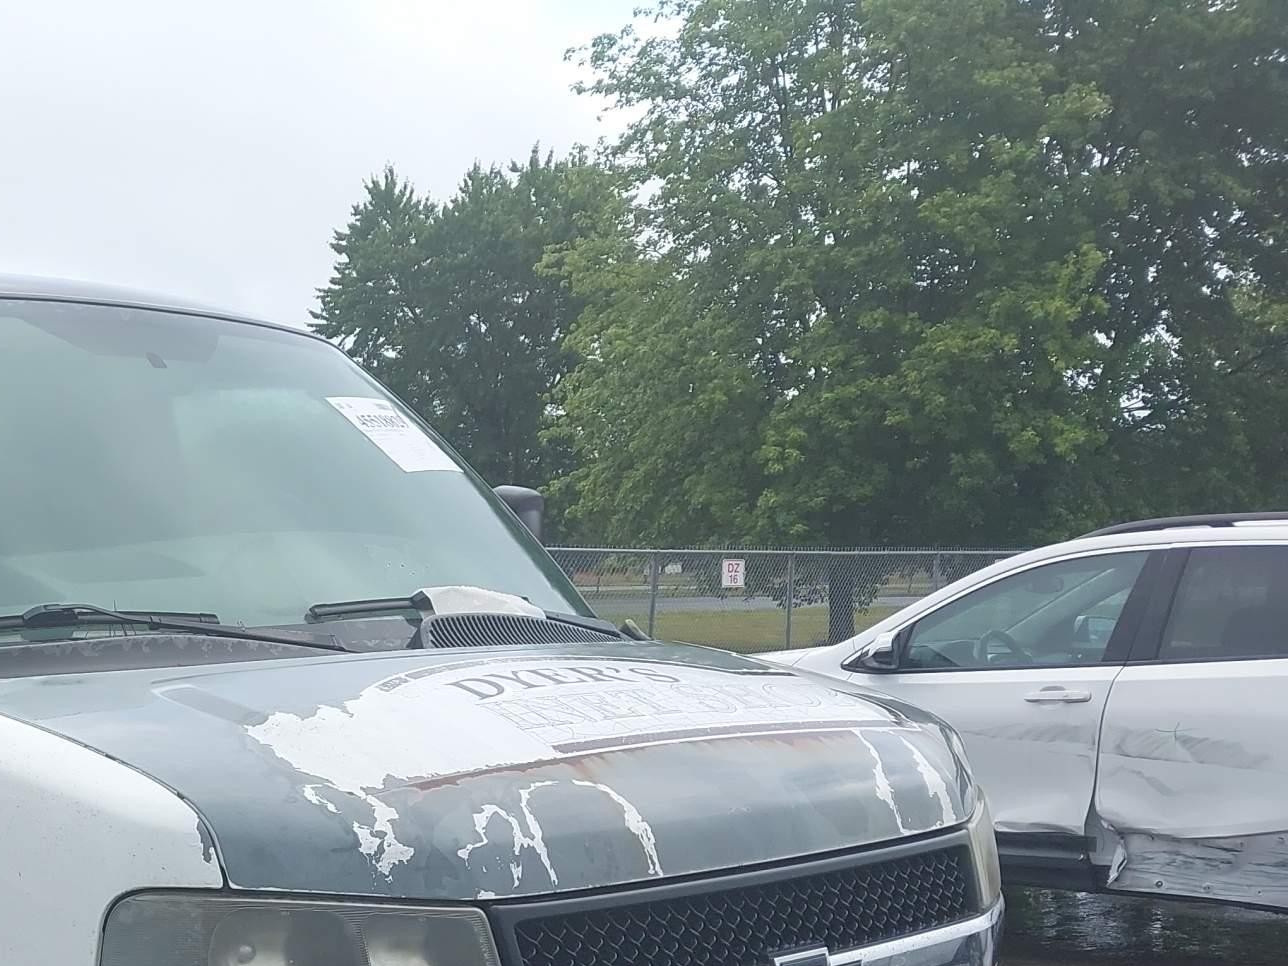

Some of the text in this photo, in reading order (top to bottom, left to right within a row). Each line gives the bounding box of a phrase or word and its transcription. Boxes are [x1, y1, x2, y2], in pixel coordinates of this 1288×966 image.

[727, 562, 740, 573] DZ
[729, 574, 739, 584] 16
[446, 666, 681, 700] DYER'S
